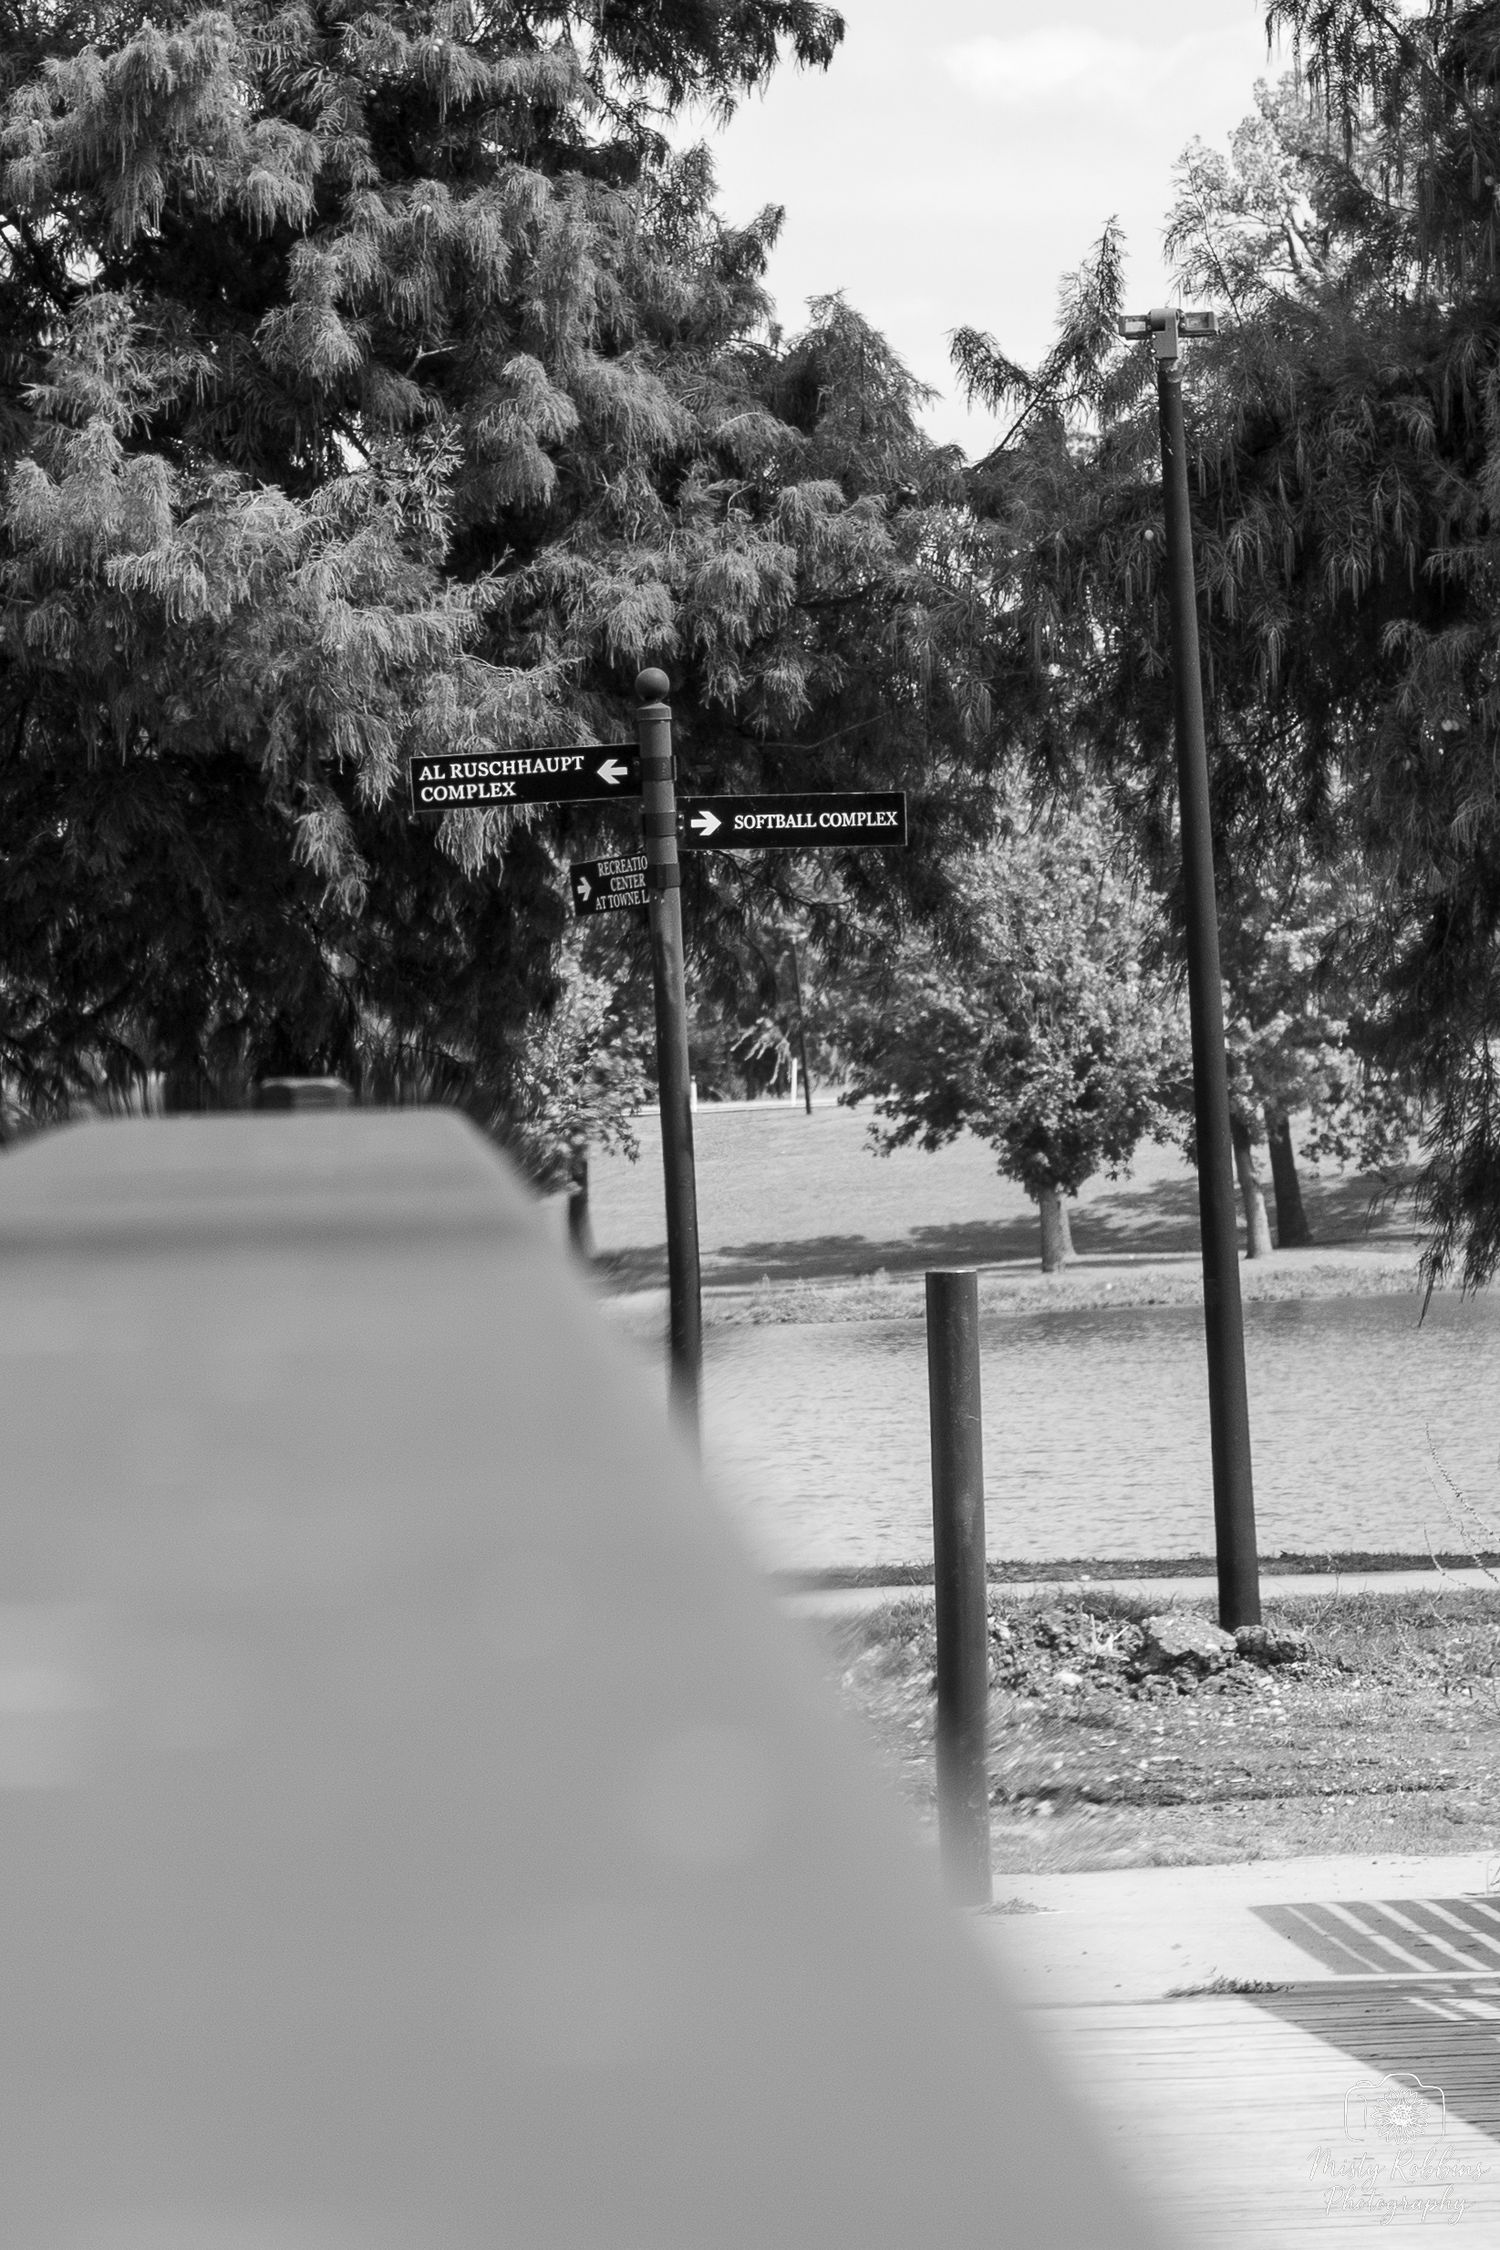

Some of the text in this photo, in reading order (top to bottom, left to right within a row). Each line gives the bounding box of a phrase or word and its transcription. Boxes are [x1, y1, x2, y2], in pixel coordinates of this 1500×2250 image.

[419, 755, 585, 781] AL RUSCHHAUPT
[420, 782, 517, 802] COMPLEX
[734, 811, 899, 830] SOFTBALL COMPLEX
[597, 855, 648, 877] RECREATIO
[610, 873, 646, 892] CENTER
[595, 889, 651, 910] AT TOWNE L
